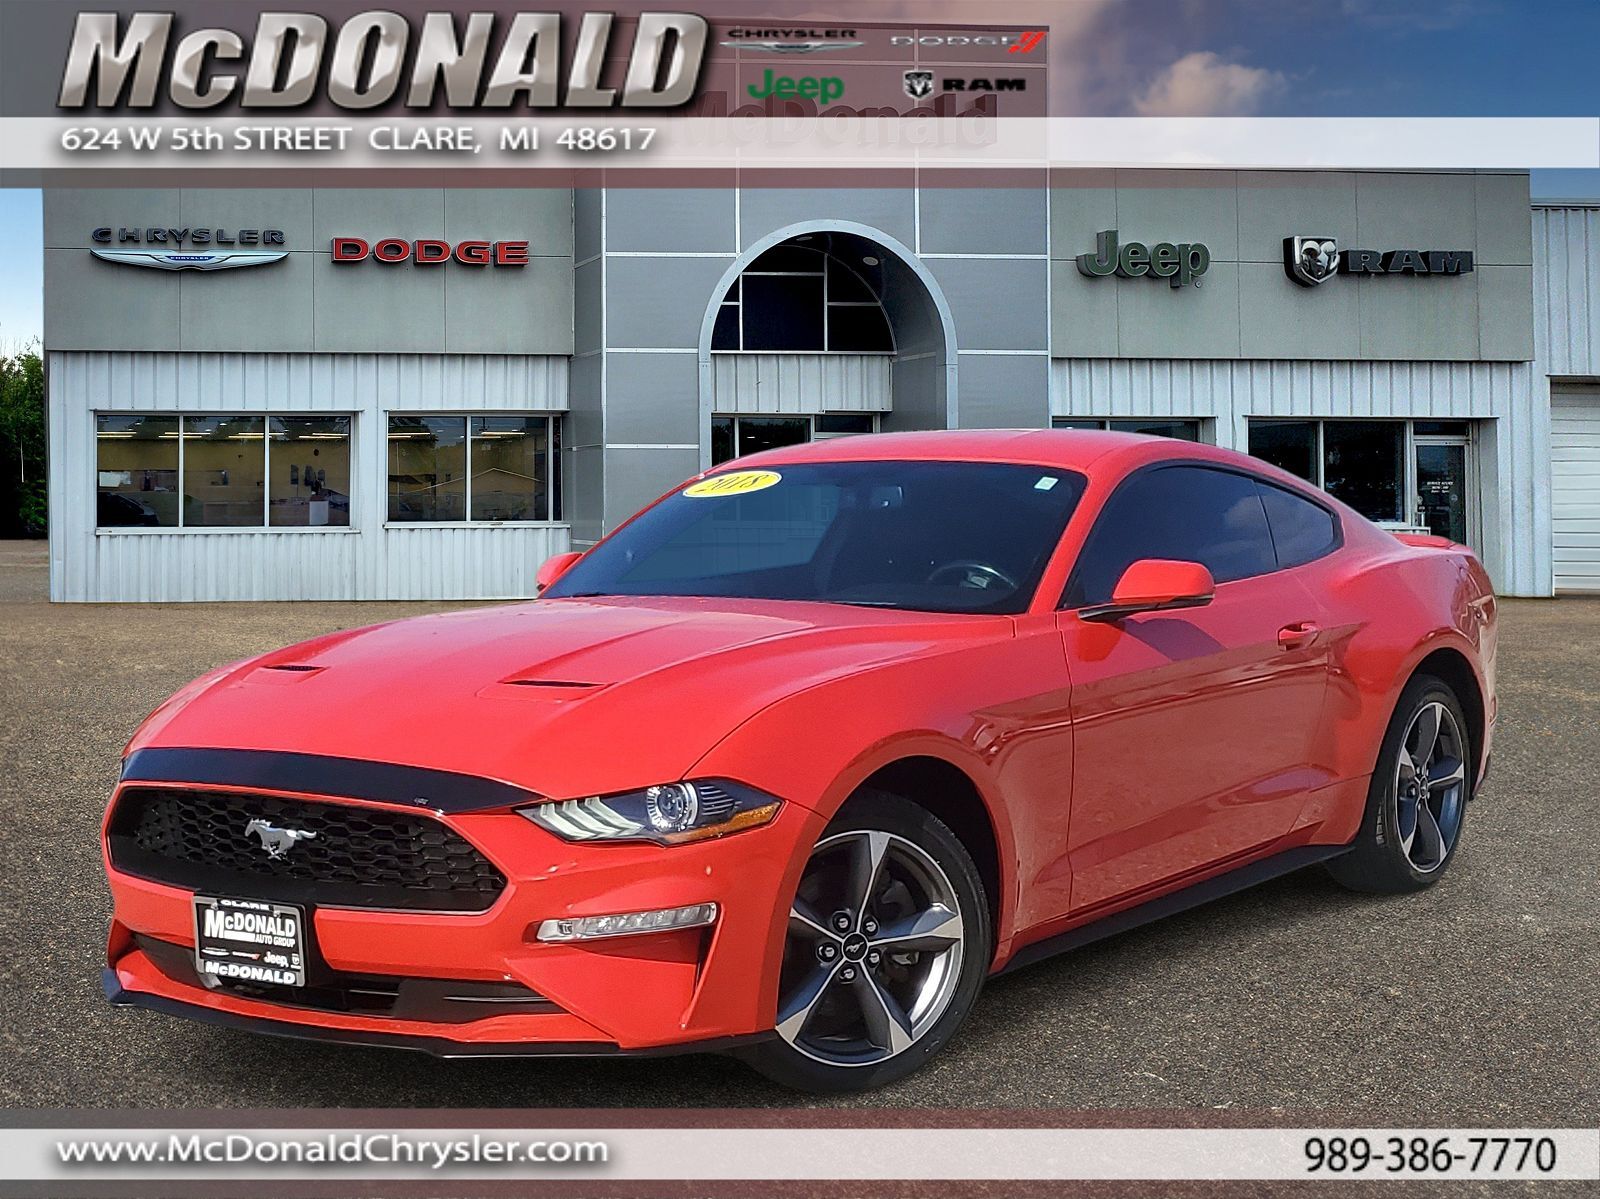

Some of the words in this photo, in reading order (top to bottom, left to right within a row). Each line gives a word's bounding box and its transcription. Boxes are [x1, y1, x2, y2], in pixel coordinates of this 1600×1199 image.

[91, 227, 286, 245] CHRYSLER
[331, 237, 530, 267] DODGE
[1077, 230, 1211, 289] Jeep
[1338, 249, 1474, 275] RAM
[204, 909, 296, 937] McDONALD
[256, 934, 272, 945] AUTO
[273, 936, 296, 948] GROUP
[264, 951, 289, 968] Jeep
[205, 961, 296, 984] McDONALD
